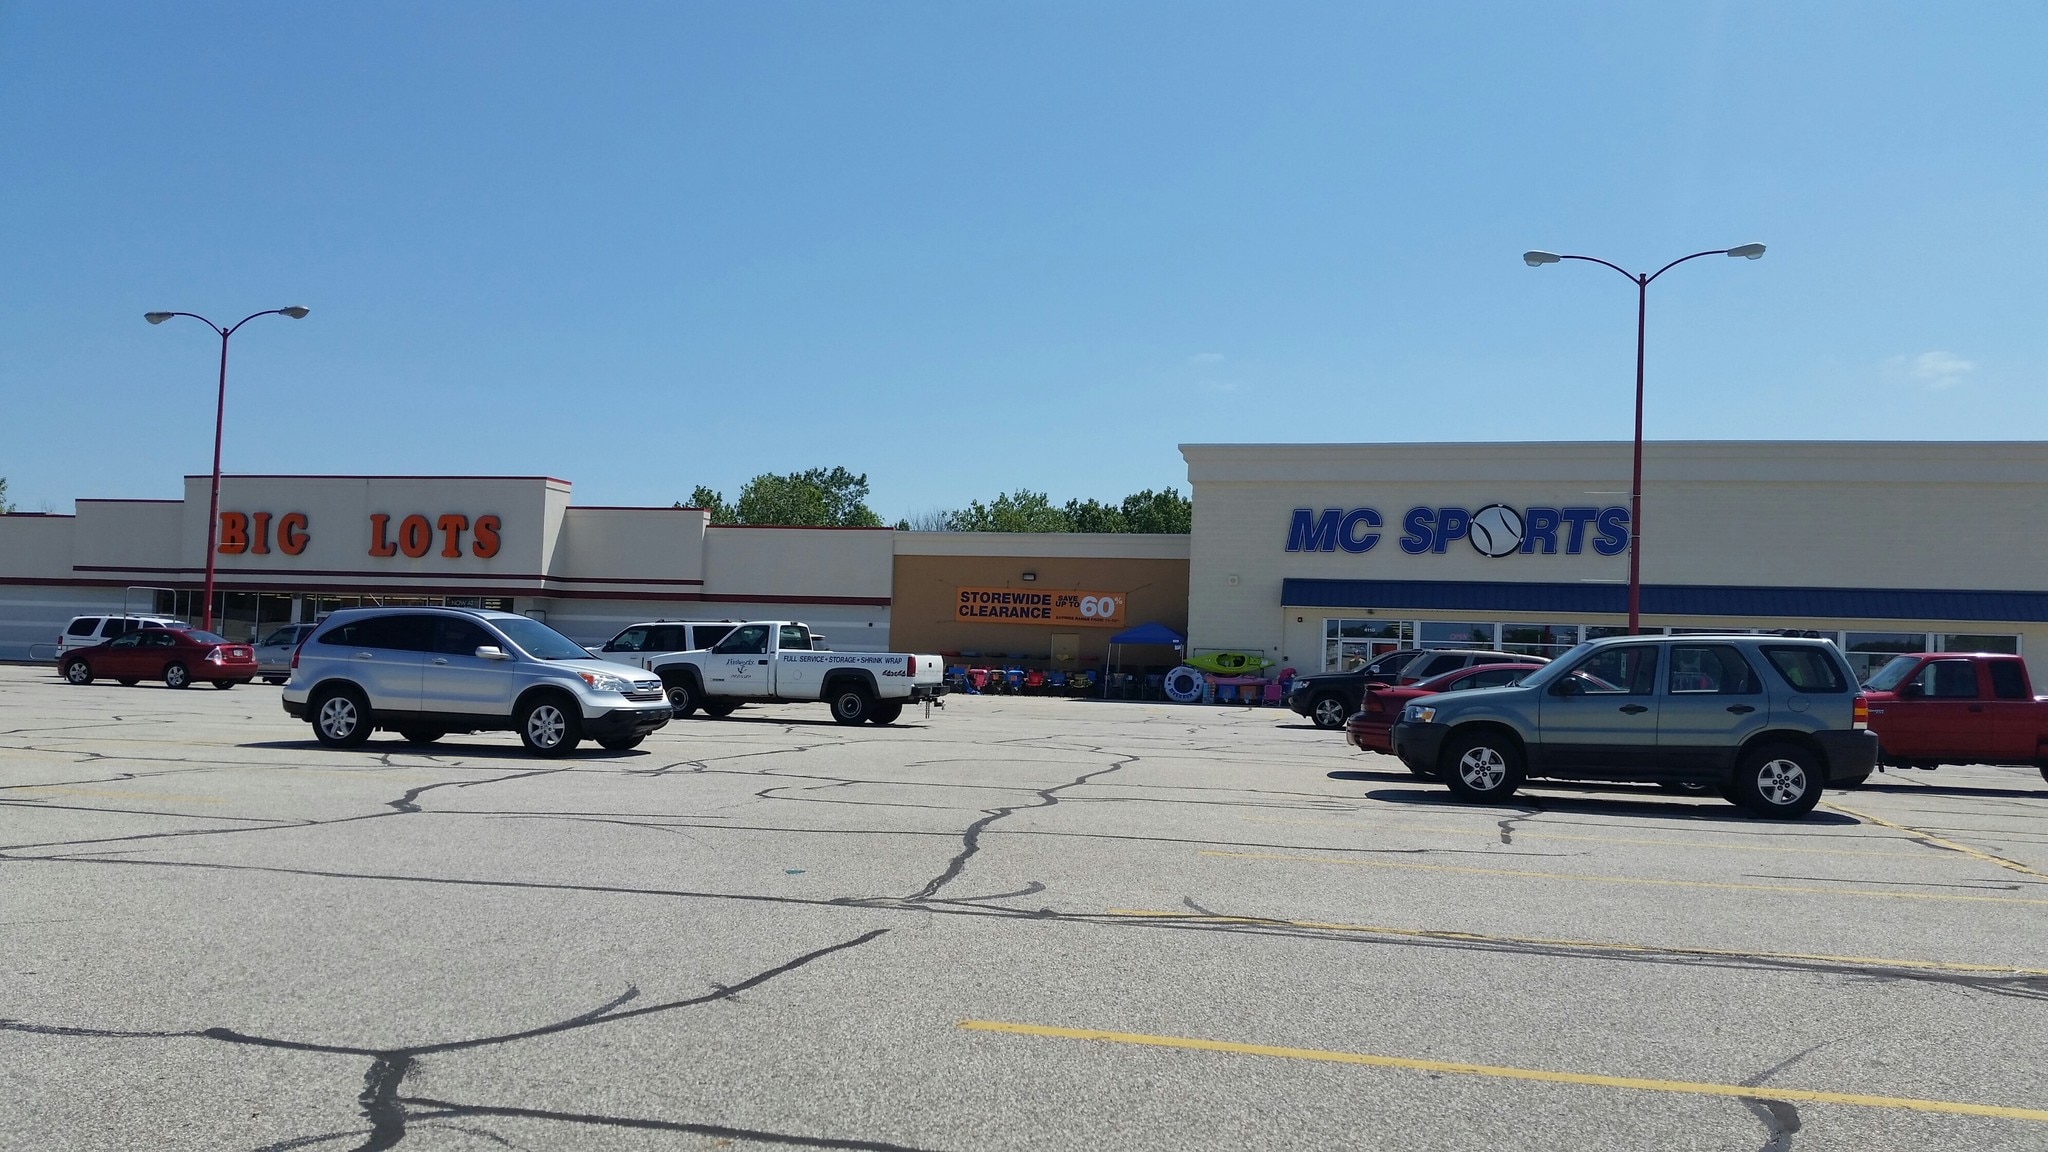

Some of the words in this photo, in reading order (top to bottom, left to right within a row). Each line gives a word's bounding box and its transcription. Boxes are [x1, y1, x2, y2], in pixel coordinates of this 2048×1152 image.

[217, 511, 310, 555] BIG
[368, 513, 501, 558] LOTS
[1285, 507, 1383, 553] MC
[960, 591, 1052, 606] STOREWIDE
[1057, 594, 1079, 602] SAVE
[959, 605, 1052, 619] CLEARANCE
[783, 655, 797, 663] FULL
[799, 655, 825, 663] SERVICE
[829, 656, 857, 664] STORAGE
